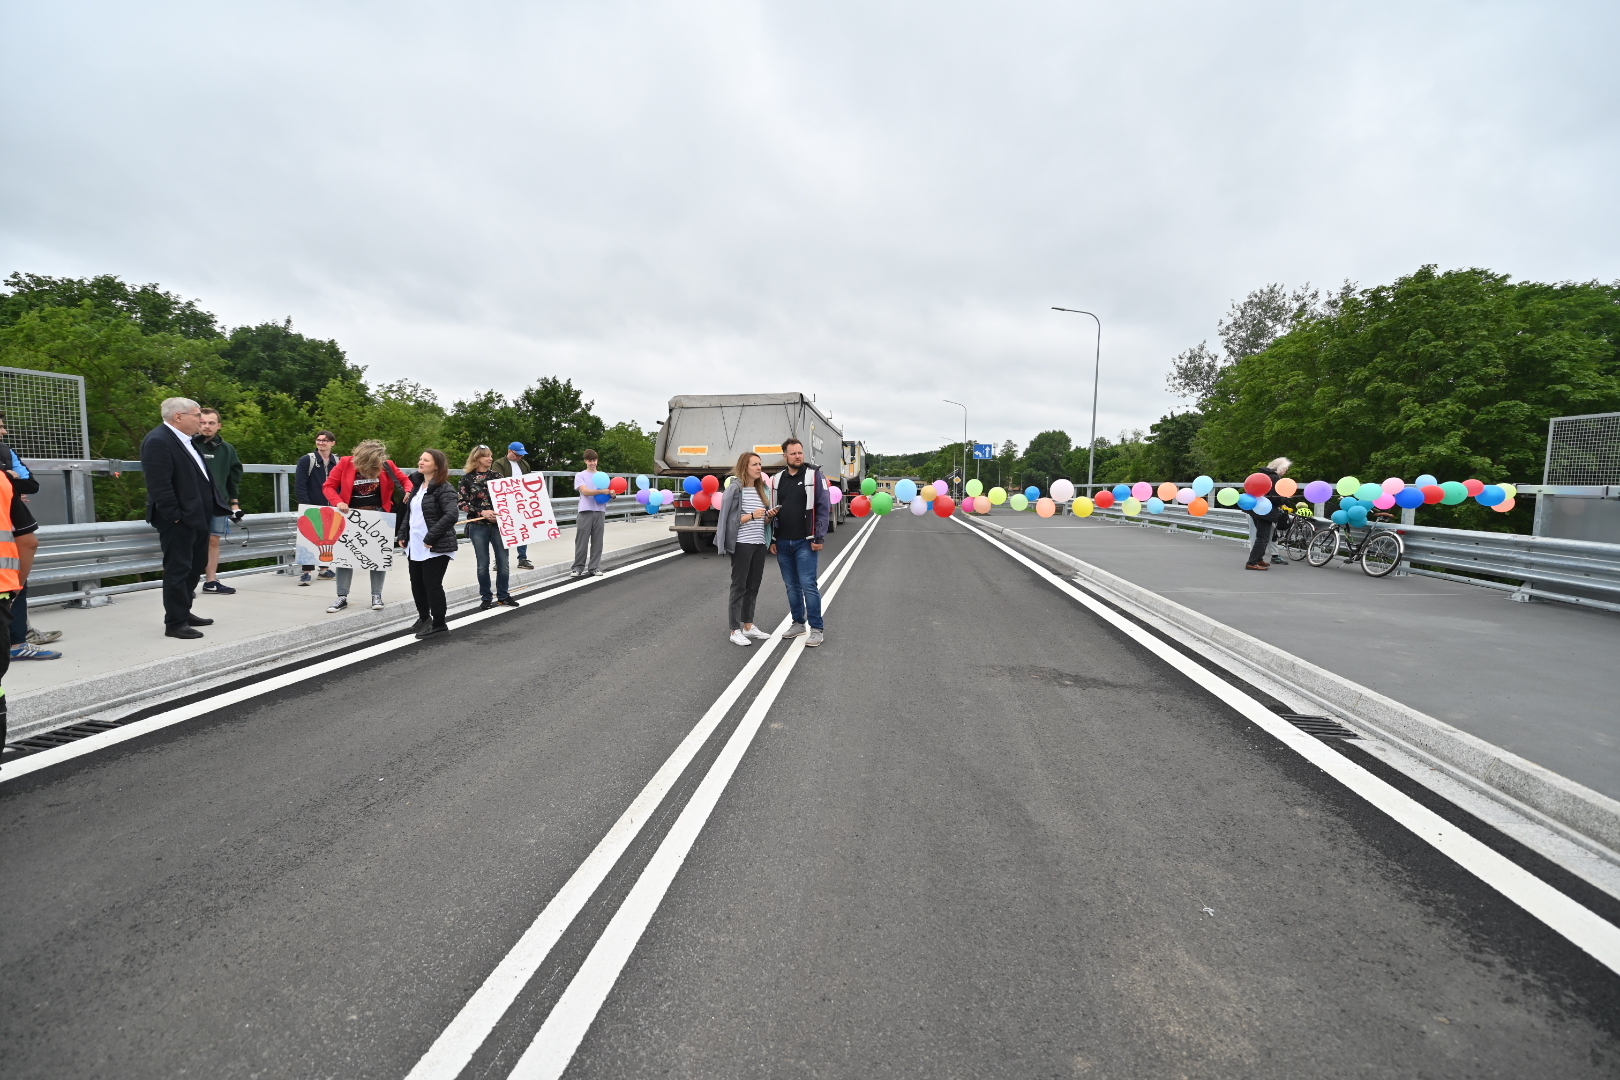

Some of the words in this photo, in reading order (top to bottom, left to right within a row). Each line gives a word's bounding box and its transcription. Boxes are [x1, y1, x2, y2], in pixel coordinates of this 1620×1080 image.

[491, 480, 518, 547] Strzeszyn
[507, 478, 527, 514] życia
[519, 523, 530, 542] na
[522, 476, 553, 528] Drogi
[347, 509, 392, 568] Balonem
[354, 531, 368, 547] na
